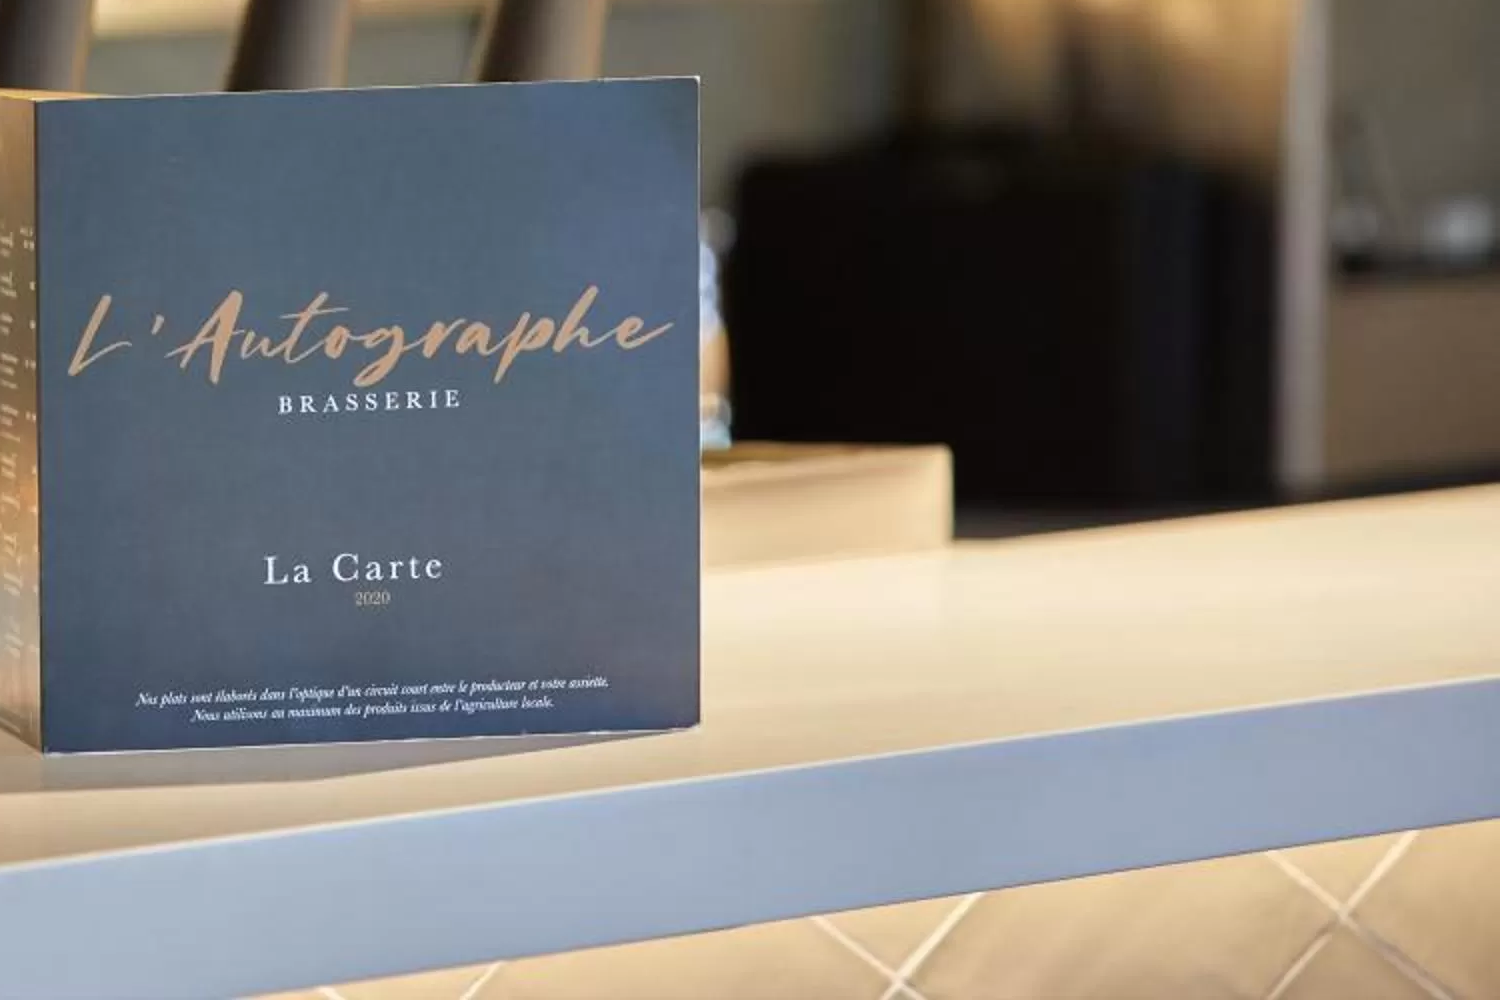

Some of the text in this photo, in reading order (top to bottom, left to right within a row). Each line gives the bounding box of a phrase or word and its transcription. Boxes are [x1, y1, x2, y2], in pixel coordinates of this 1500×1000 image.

[67, 285, 674, 387] L'Autographe
[277, 389, 461, 415] BRASSERIE
[263, 553, 443, 585] La Carte
[355, 591, 392, 606] 2020
[135, 692, 158, 707] Nos
[159, 692, 187, 708] plats
[259, 687, 286, 701] dans
[363, 682, 399, 697] circuit
[401, 682, 428, 695] court
[429, 682, 456, 694] entre
[457, 680, 469, 693] le
[469, 679, 527, 696] producteur
[527, 679, 540, 691] et
[190, 708, 219, 722] Nous
[271, 708, 286, 719] au
[288, 705, 341, 718] maximum
[344, 703, 361, 716] des
[363, 701, 408, 718] produits
[439, 699, 452, 713] de
[453, 698, 519, 714] l'agriculture
